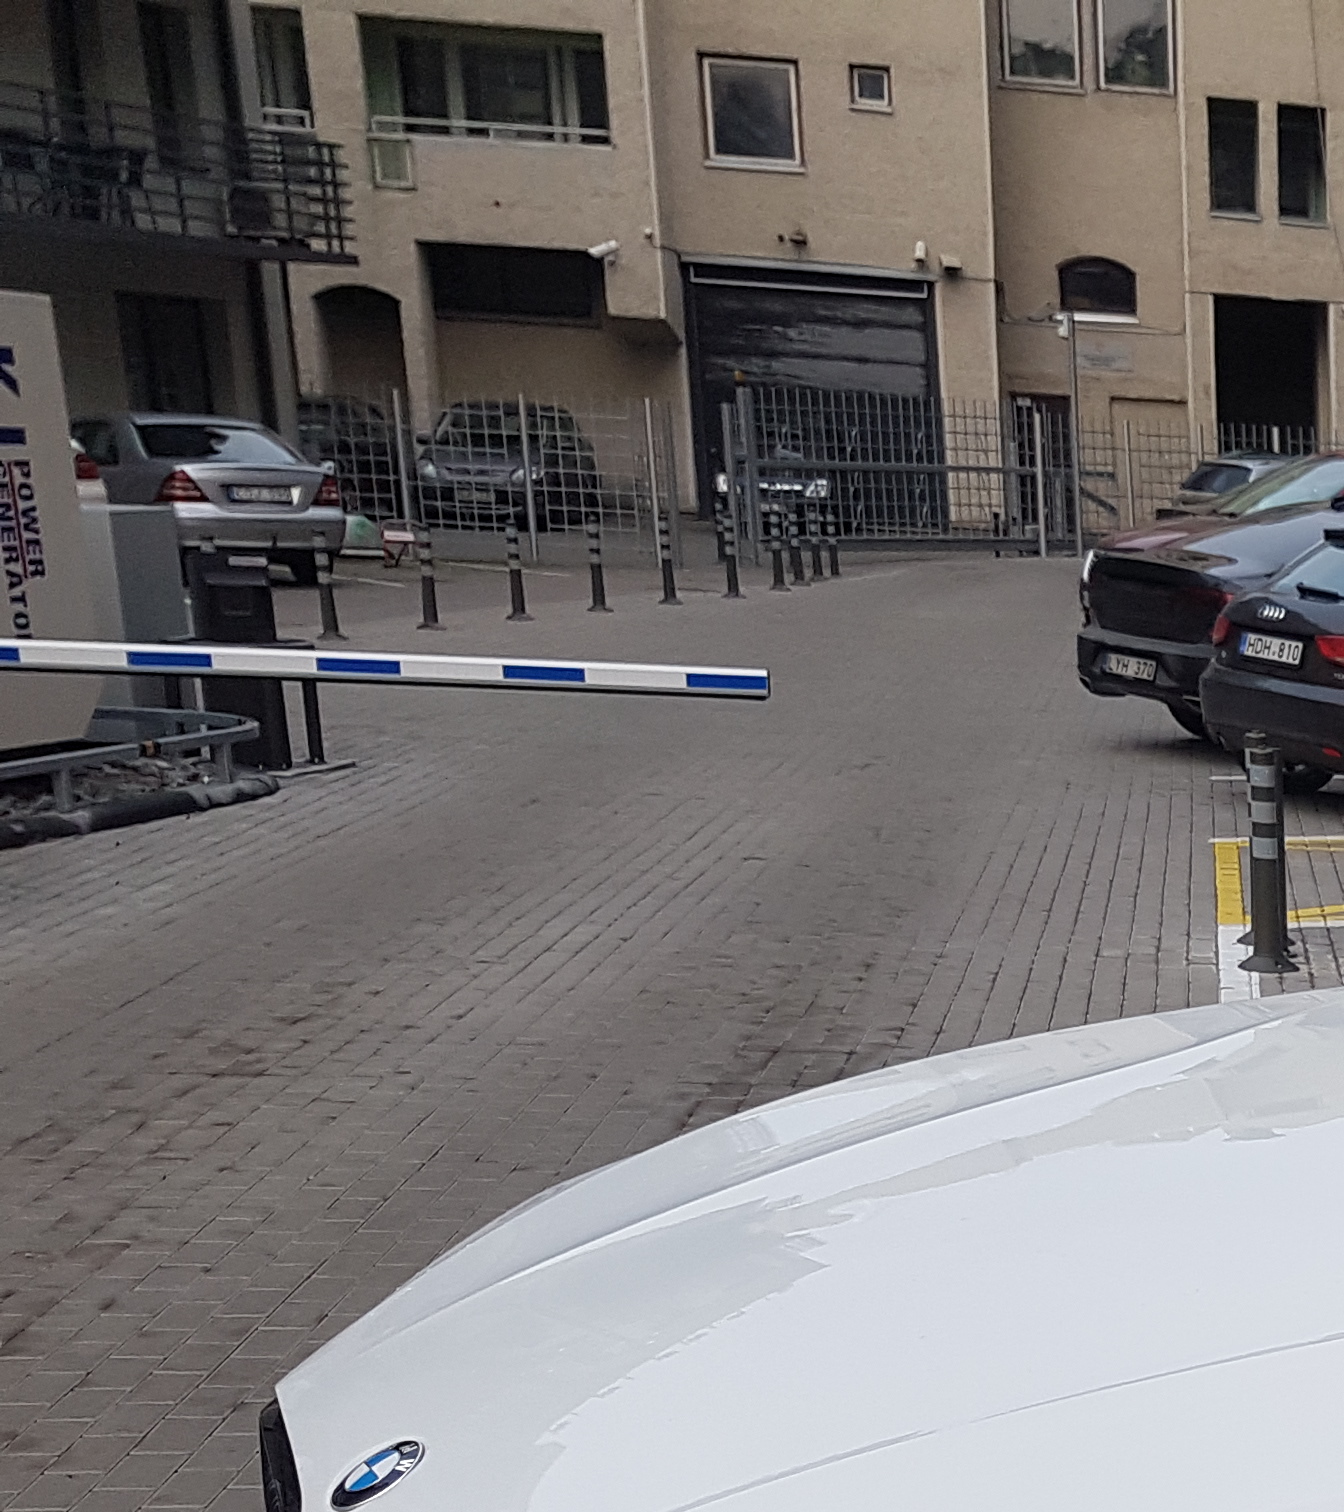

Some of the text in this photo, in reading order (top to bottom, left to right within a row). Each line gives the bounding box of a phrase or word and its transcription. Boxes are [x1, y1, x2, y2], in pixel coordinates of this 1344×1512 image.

[13, 459, 46, 578] POWER
[1246, 636, 1300, 662] HDH 810
[1134, 660, 1154, 678] 370
